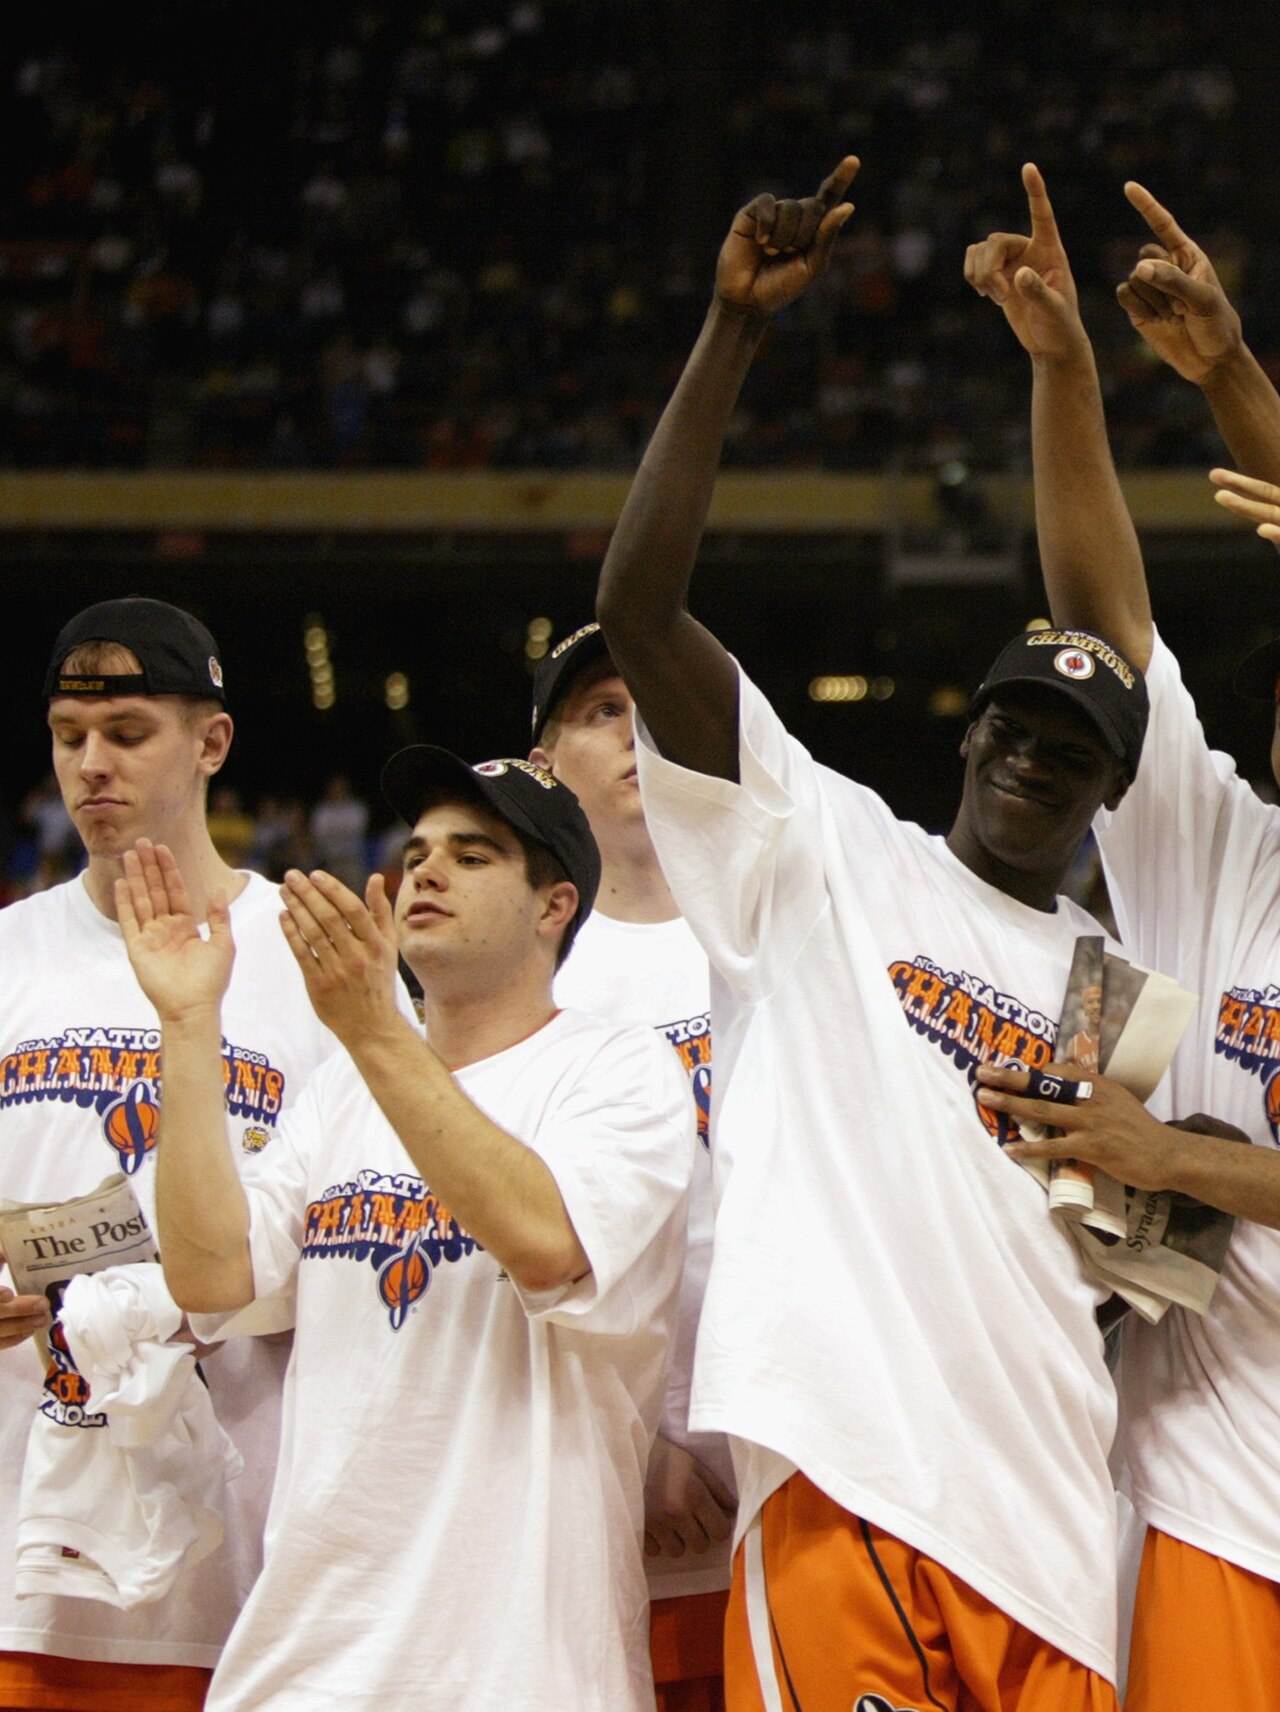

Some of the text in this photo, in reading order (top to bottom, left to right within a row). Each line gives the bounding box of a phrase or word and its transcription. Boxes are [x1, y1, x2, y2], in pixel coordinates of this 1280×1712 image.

[1026, 632, 1136, 691] CHAMPIONS
[888, 961, 1054, 1074] CHAMP
[914, 955, 1061, 1048] NCAA NATION
[16, 1038, 60, 1055] NCAA
[232, 1047, 268, 1068] 2003
[23, 1235, 87, 1260] The
